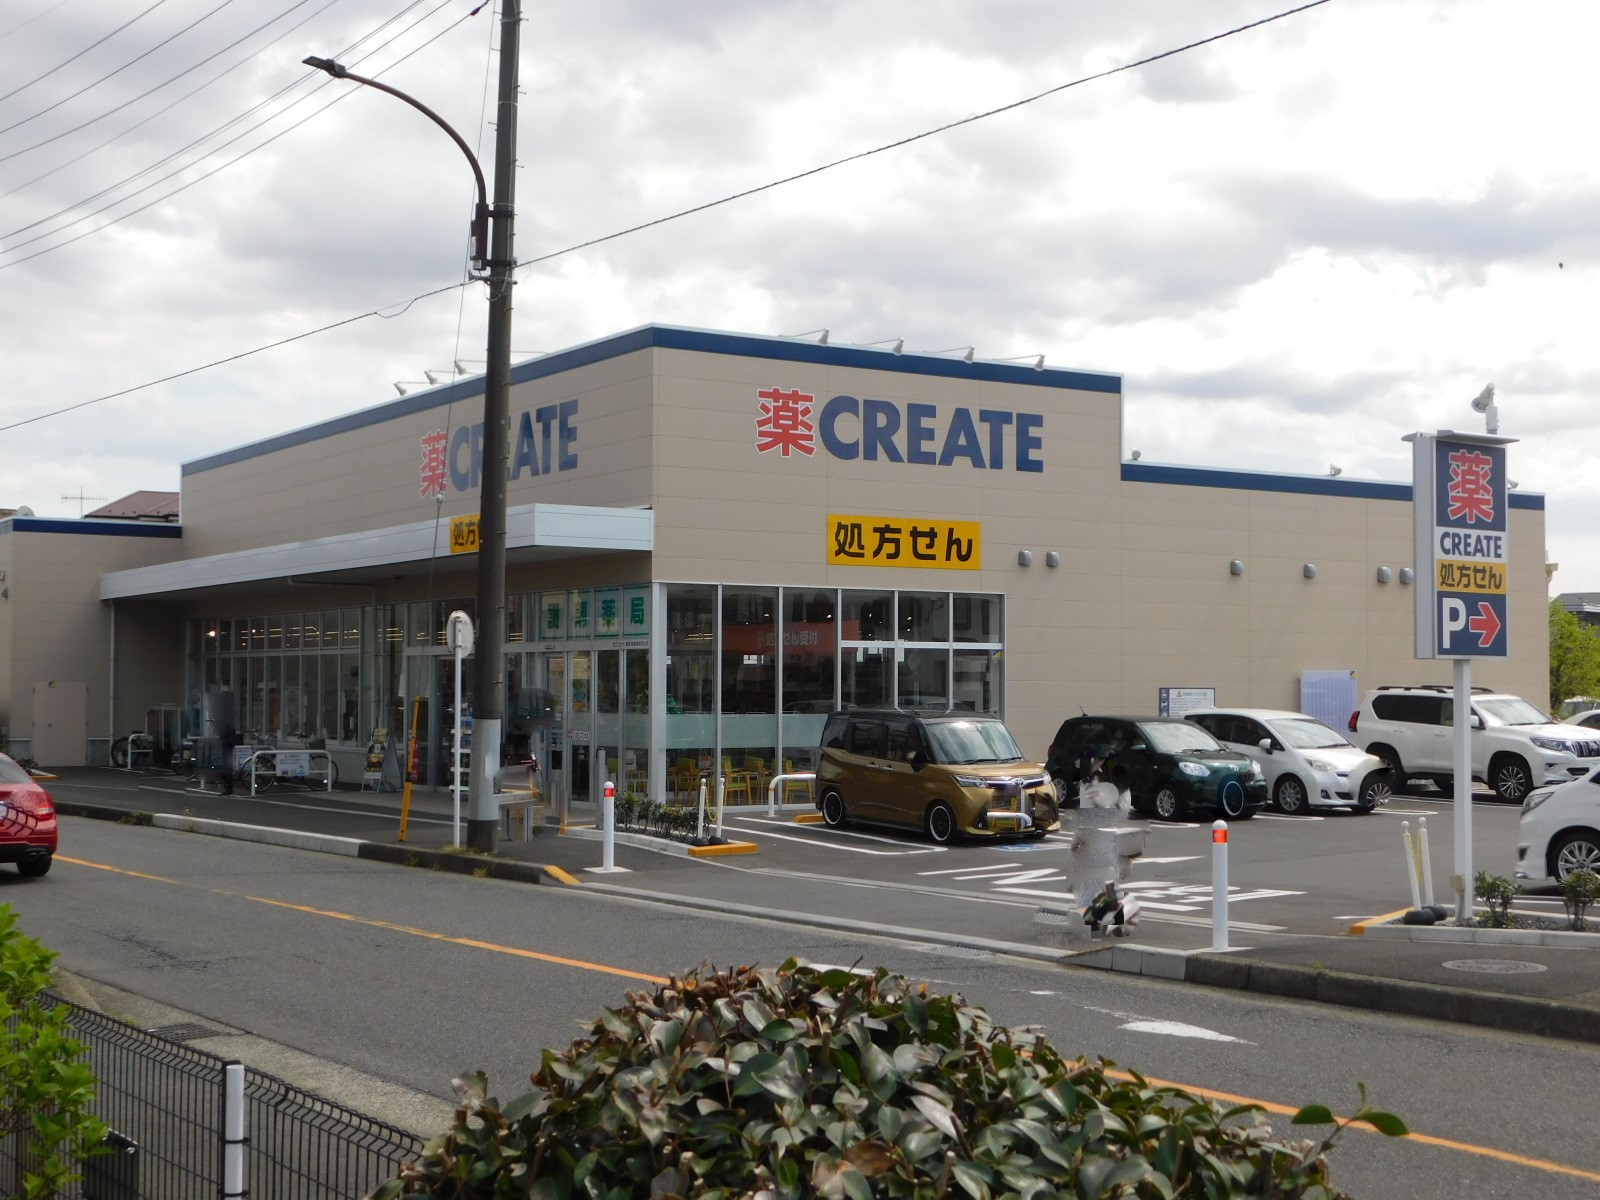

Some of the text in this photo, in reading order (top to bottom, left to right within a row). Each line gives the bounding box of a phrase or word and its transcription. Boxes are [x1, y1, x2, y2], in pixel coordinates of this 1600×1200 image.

[420, 399, 578, 499] 薬 CRATE
[754, 386, 1044, 473] 薬 CREATE
[1447, 449, 1495, 524] 薬
[453, 519, 481, 547] 処方
[834, 521, 973, 562] 処方せん
[1439, 531, 1503, 558] CREATE
[1440, 562, 1503, 590] 処方せん
[1442, 597, 1467, 649] P
